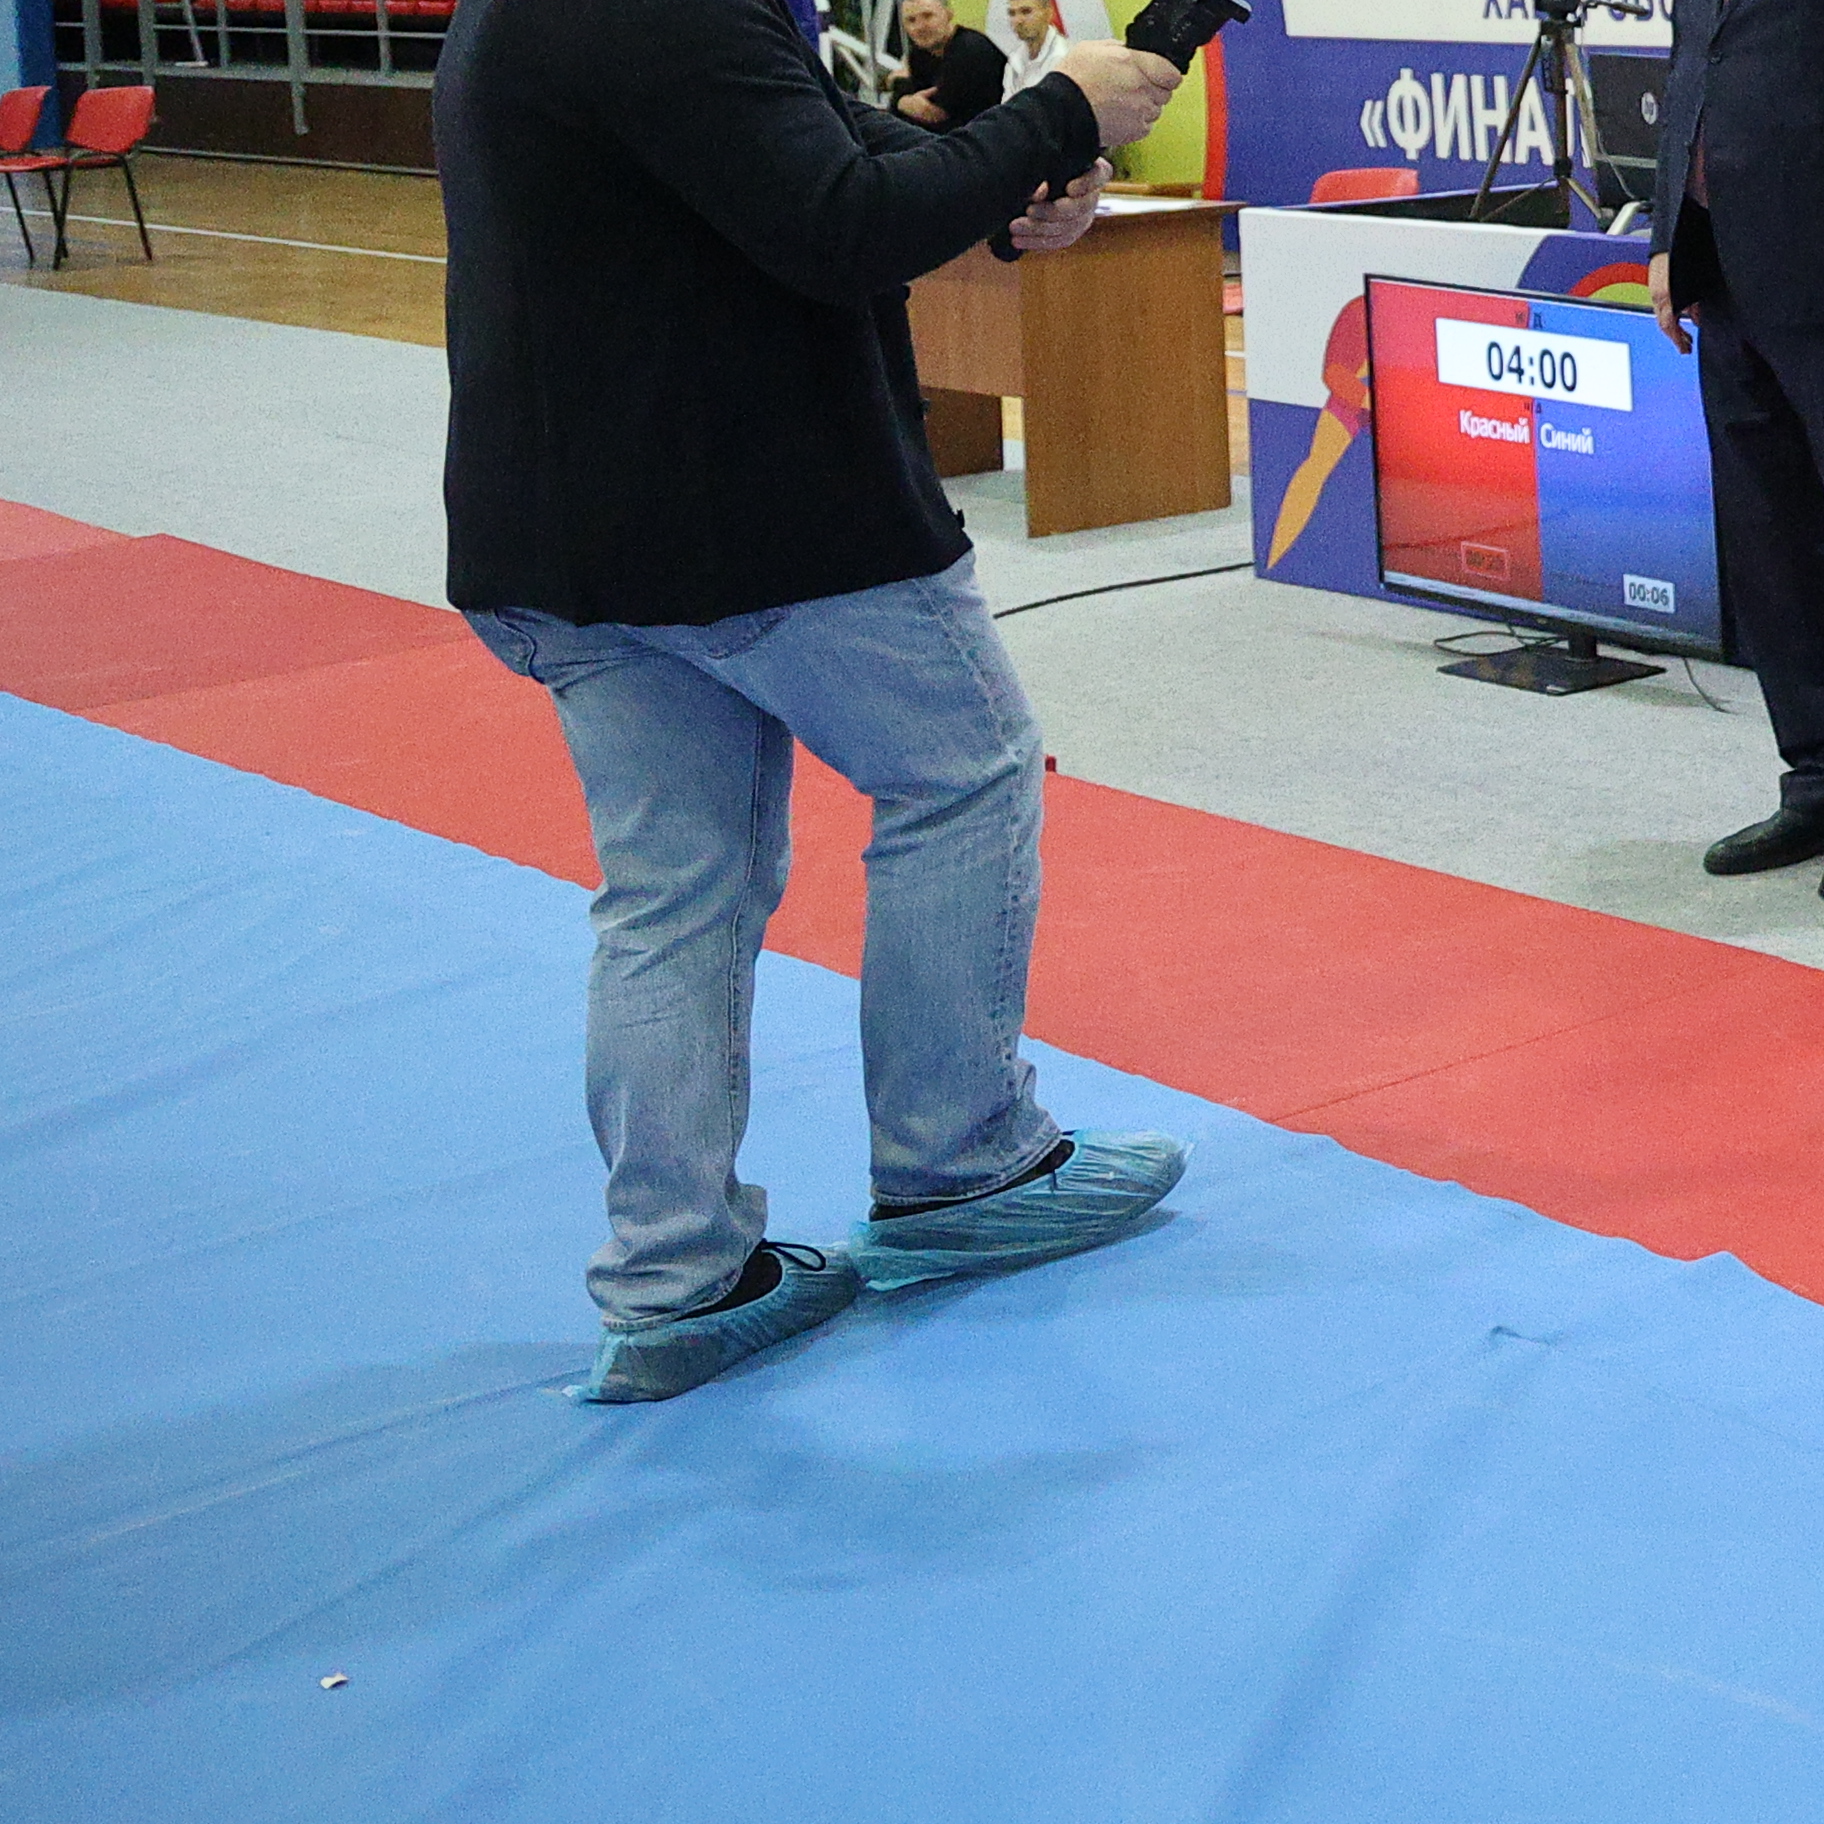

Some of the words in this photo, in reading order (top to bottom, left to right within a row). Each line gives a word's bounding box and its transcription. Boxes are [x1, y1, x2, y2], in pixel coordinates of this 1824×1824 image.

[1487, 341, 1578, 392] 04:00
[1459, 409, 1531, 444] Красный
[1540, 422, 1595, 456] Синий
[1628, 582, 1671, 607] 00:06
